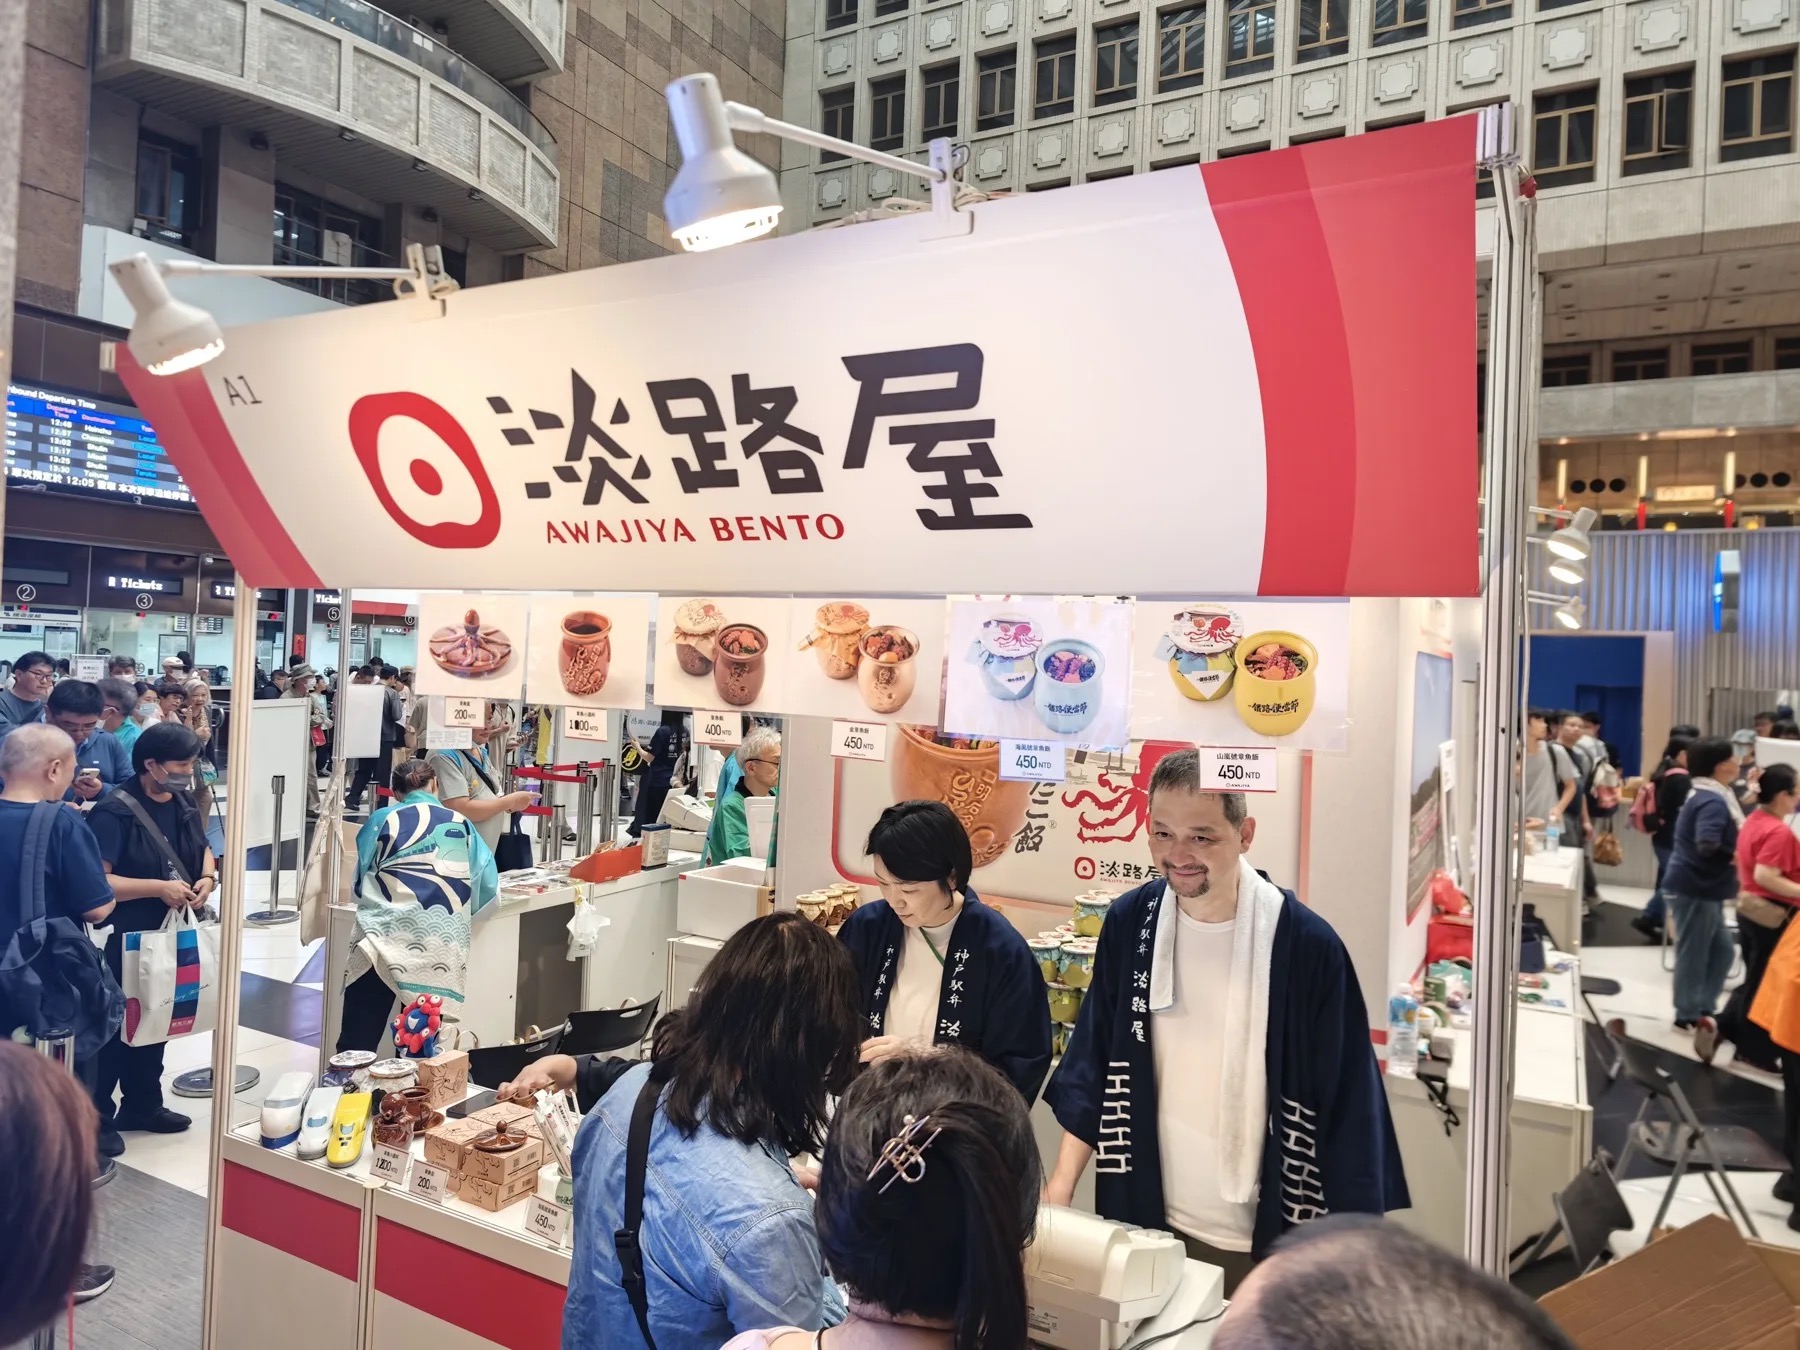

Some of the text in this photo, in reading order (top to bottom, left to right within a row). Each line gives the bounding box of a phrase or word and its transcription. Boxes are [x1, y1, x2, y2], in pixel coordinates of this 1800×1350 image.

[223, 375, 262, 406] A1
[39, 391, 76, 406] Departure
[77, 399, 96, 410] Time
[487, 342, 1032, 530] 淡路屋
[66, 475, 95, 487] 12:05
[546, 514, 846, 544] AWAJIYA BENTO
[454, 708, 468, 720] 200
[569, 719, 589, 731] 100
[705, 723, 721, 736] 400
[844, 736, 862, 750] 450
[1015, 755, 1052, 769] 450 NTD
[1218, 764, 1261, 779] 450 NTD
[417, 1175, 431, 1190] 200
[534, 1212, 549, 1229] 450
